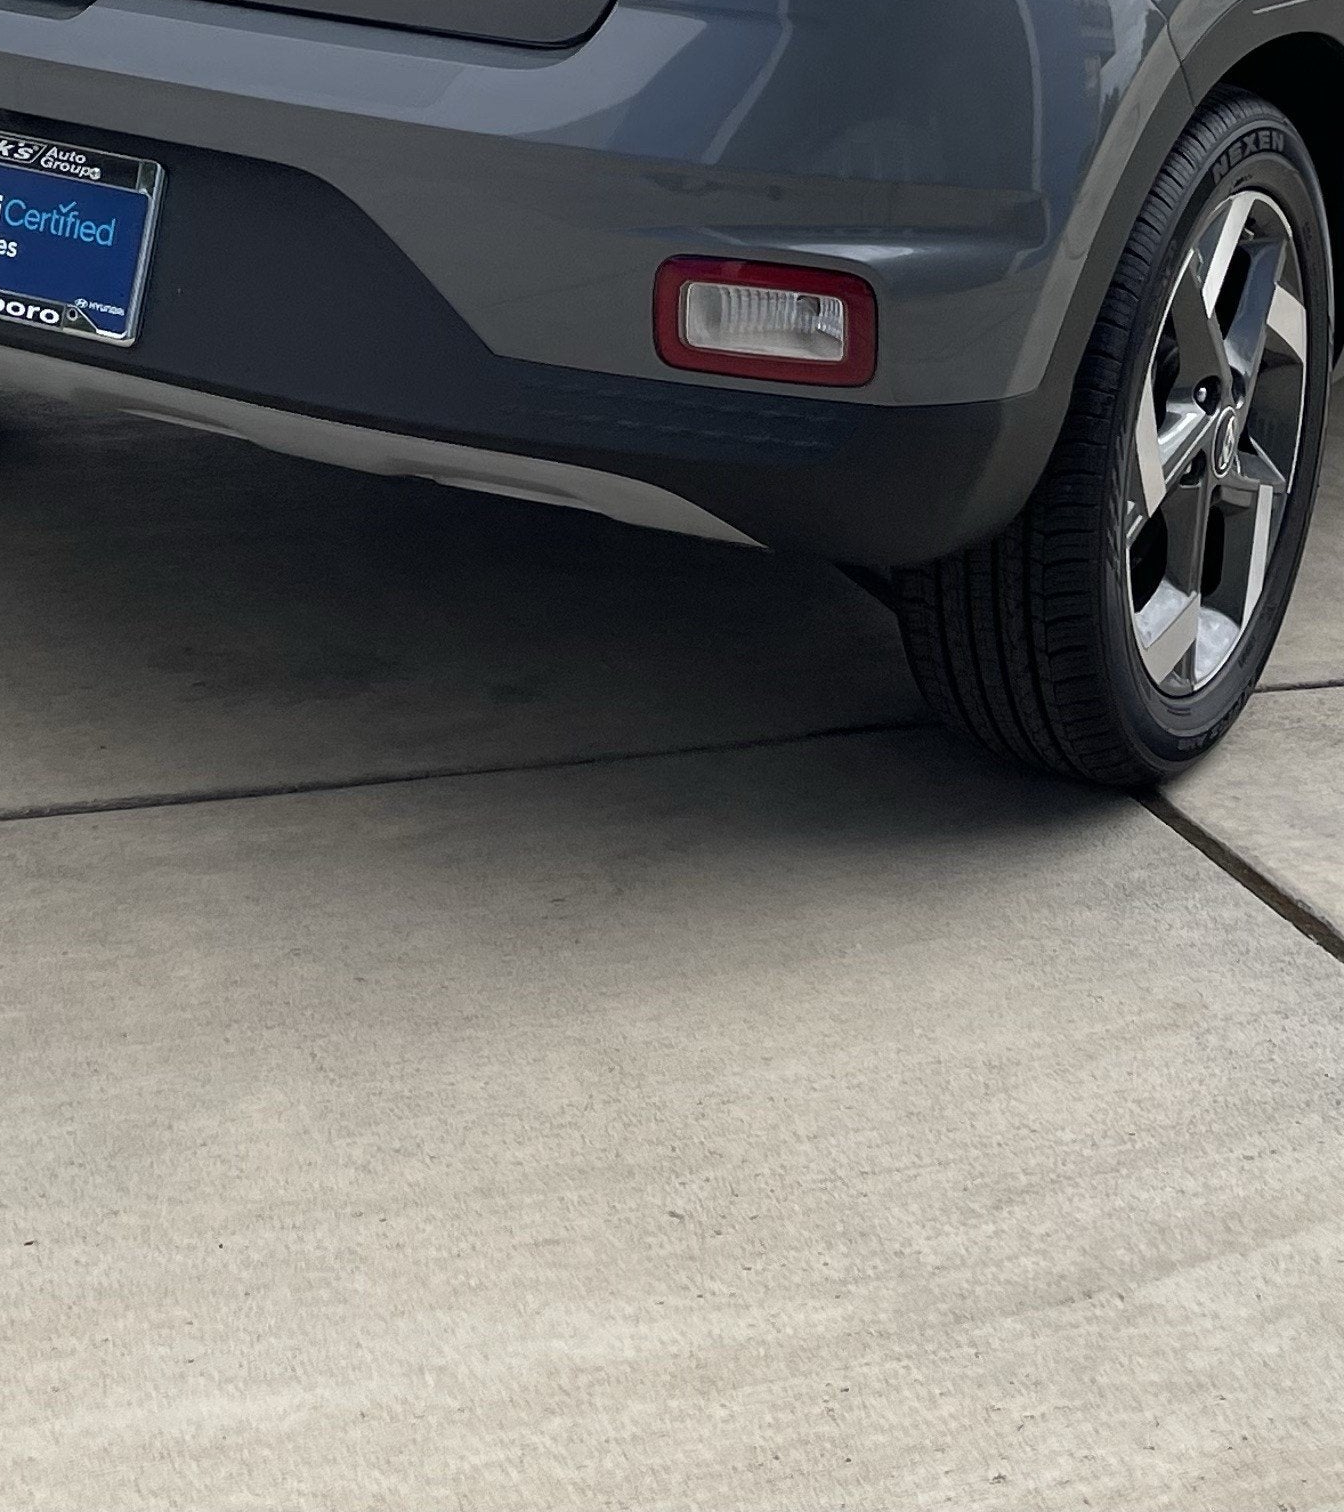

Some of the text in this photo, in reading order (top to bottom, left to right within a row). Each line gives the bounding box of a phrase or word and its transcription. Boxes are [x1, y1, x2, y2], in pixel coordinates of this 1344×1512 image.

[45, 146, 87, 164] Auto
[1211, 129, 1285, 186] NEXEN
[5, 199, 117, 247] Certified
